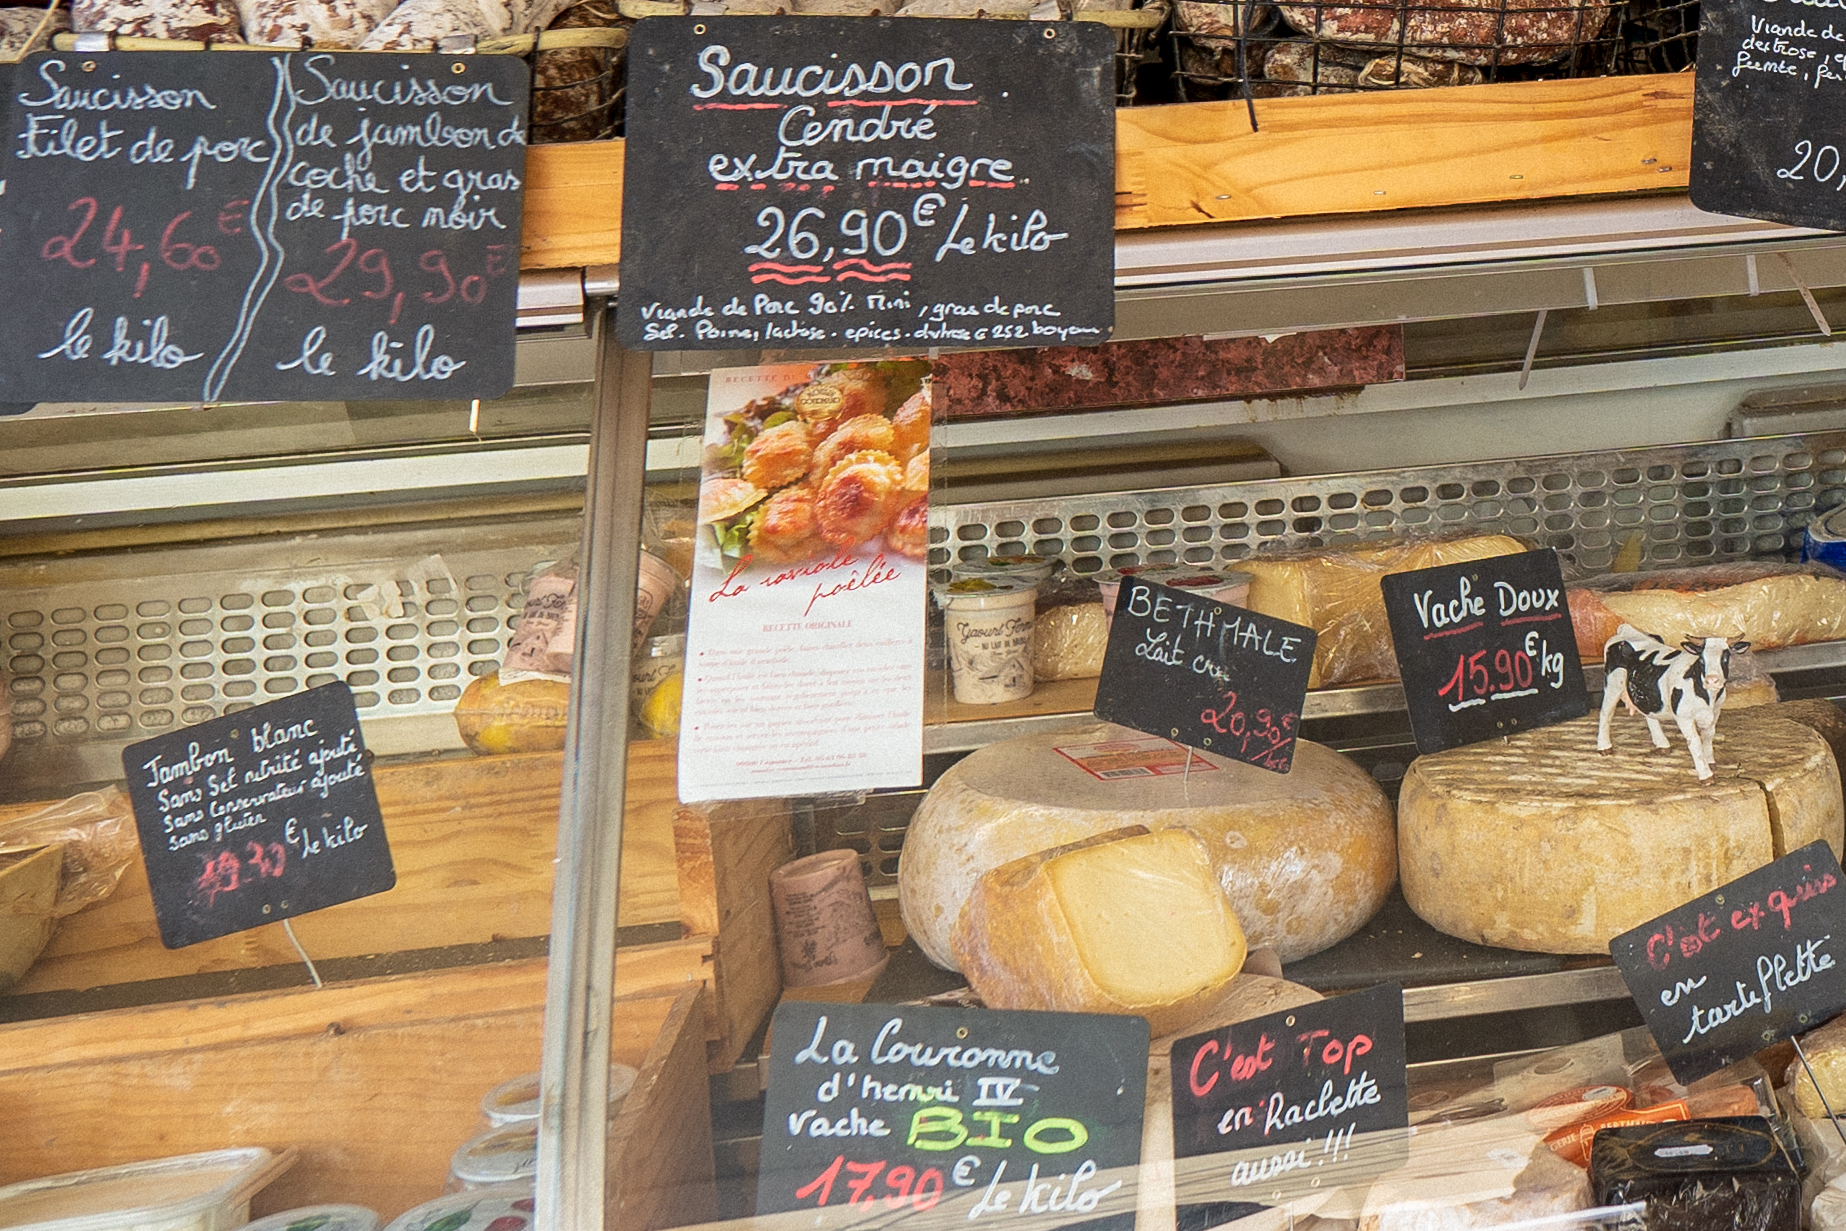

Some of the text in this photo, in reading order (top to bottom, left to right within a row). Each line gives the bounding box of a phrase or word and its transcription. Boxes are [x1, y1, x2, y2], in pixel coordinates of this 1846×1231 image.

[1750, 14, 1818, 40] Viande
[1820, 21, 1844, 43] de
[17, 58, 217, 110] Saucisson
[293, 54, 514, 107] Saucisson
[690, 43, 974, 100] Saucisson
[14, 112, 270, 190] Filet de porc
[294, 108, 489, 173] de jambon
[777, 103, 938, 148] Cendré
[286, 152, 521, 215] coche et gras
[708, 146, 1016, 190] extra maigre
[284, 195, 507, 242] de porc noir
[981, 208, 1069, 254] kilo
[639, 295, 716, 321] Viande
[722, 296, 746, 318] de
[753, 293, 800, 317] Porc
[808, 293, 854, 317] 90%
[932, 301, 981, 321] gras
[1006, 301, 1061, 321] porc
[104, 317, 204, 371] kilo
[356, 324, 467, 382] kilo
[804, 553, 901, 617] poêlée
[1413, 576, 1559, 629] Vache Doux
[1127, 585, 1302, 663] BETHMALE
[1135, 627, 1185, 666] Lait
[142, 719, 319, 789] Jambon blanc
[157, 786, 202, 813] Sans
[308, 728, 358, 774] ajouté
[163, 753, 365, 834] Sans ajouté
[168, 811, 267, 852] sans gluten
[323, 816, 369, 849] kilo
[1646, 913, 1721, 970] C'est
[869, 1017, 1061, 1076] Couronne
[1189, 1029, 1374, 1097] C'est Top
[816, 1072, 960, 1104] d'henri
[787, 1105, 1090, 1155] vache BIO
[1018, 1159, 1123, 1214] kilo
